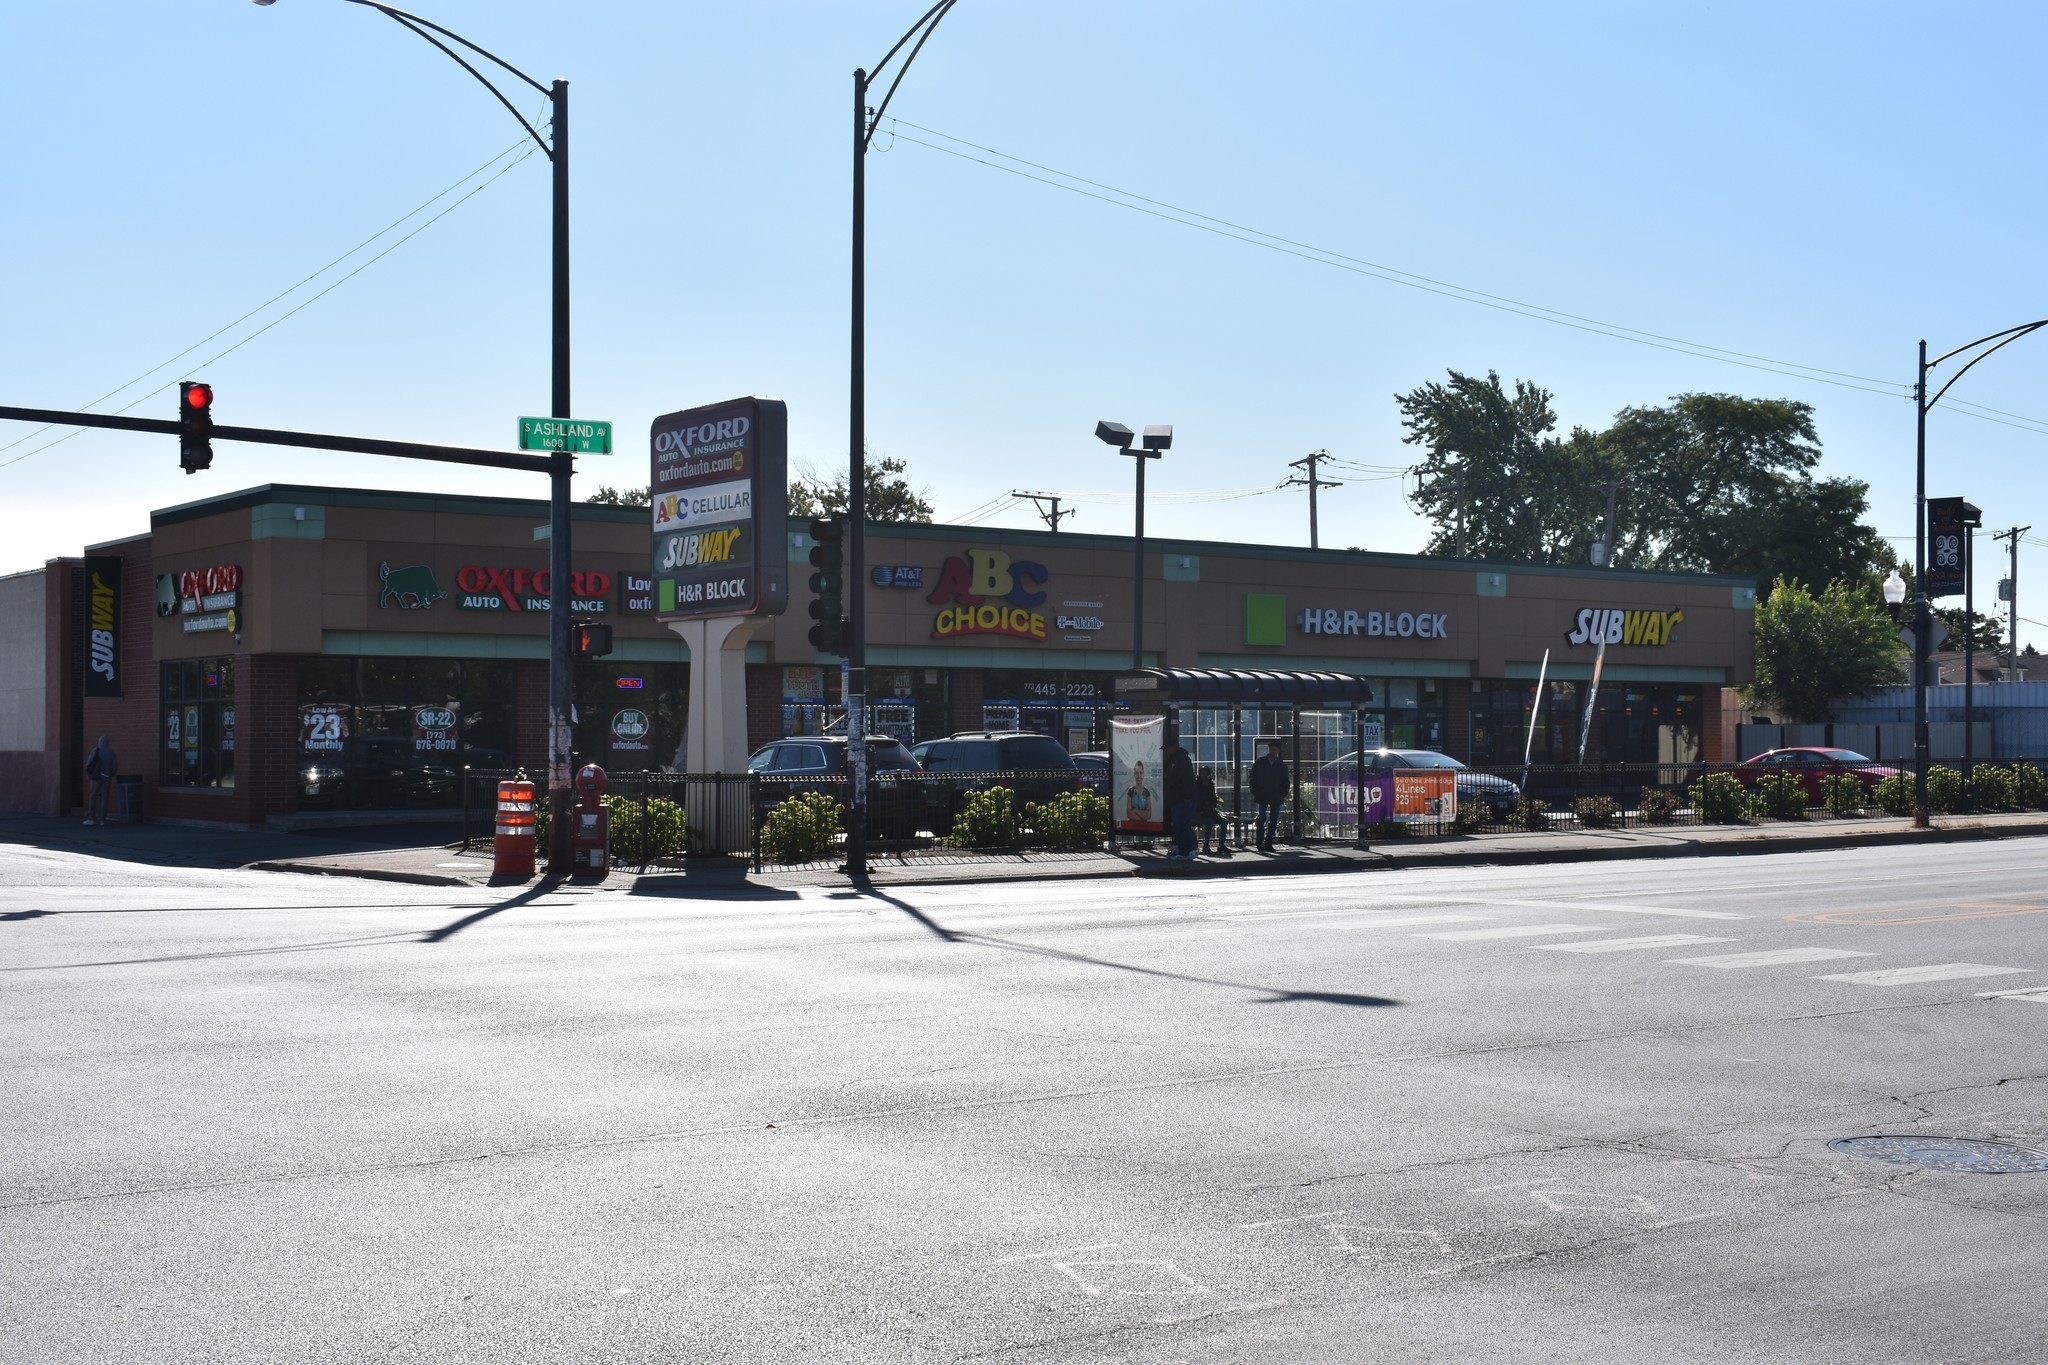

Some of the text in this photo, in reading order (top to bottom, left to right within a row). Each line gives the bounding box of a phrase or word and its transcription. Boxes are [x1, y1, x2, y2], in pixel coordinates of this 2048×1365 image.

[524, 422, 607, 438] S ASHLAND AV
[655, 416, 750, 459] OXFORD
[542, 438, 590, 449] 1600 W
[657, 438, 745, 463] AUTO INSURANCE
[659, 456, 733, 482] oxfordauto.com
[655, 491, 750, 524] ABC CELLULAR
[662, 526, 742, 570] SUBWAY
[894, 567, 922, 580] AT&T
[926, 549, 1049, 608] ABC
[181, 564, 239, 614] OXFORD
[678, 578, 746, 603] H&R BLOCK
[463, 596, 605, 612] AUTO INSANCE
[91, 572, 115, 682] SUBWAY
[183, 616, 228, 631] oxfordauto.com
[936, 605, 1047, 638] CHOICE
[1303, 607, 1449, 639] H&R BLOCK
[1568, 607, 1685, 646] SUBWAY
[616, 679, 641, 688] OPEN
[1024, 682, 1035, 691] 773
[1034, 683, 1057, 696] 445
[312, 706, 326, 714] Low
[622, 711, 640, 725] BUY
[877, 709, 911, 724] FREE
[985, 709, 1016, 720] PREPAID
[303, 713, 341, 741] $23
[420, 711, 451, 727] SR-22
[616, 723, 645, 736] ONLINE
[1364, 725, 1379, 736] TAX
[304, 739, 345, 752] Monthly
[415, 739, 457, 751] 676-0070
[1402, 783, 1426, 794] Lines
